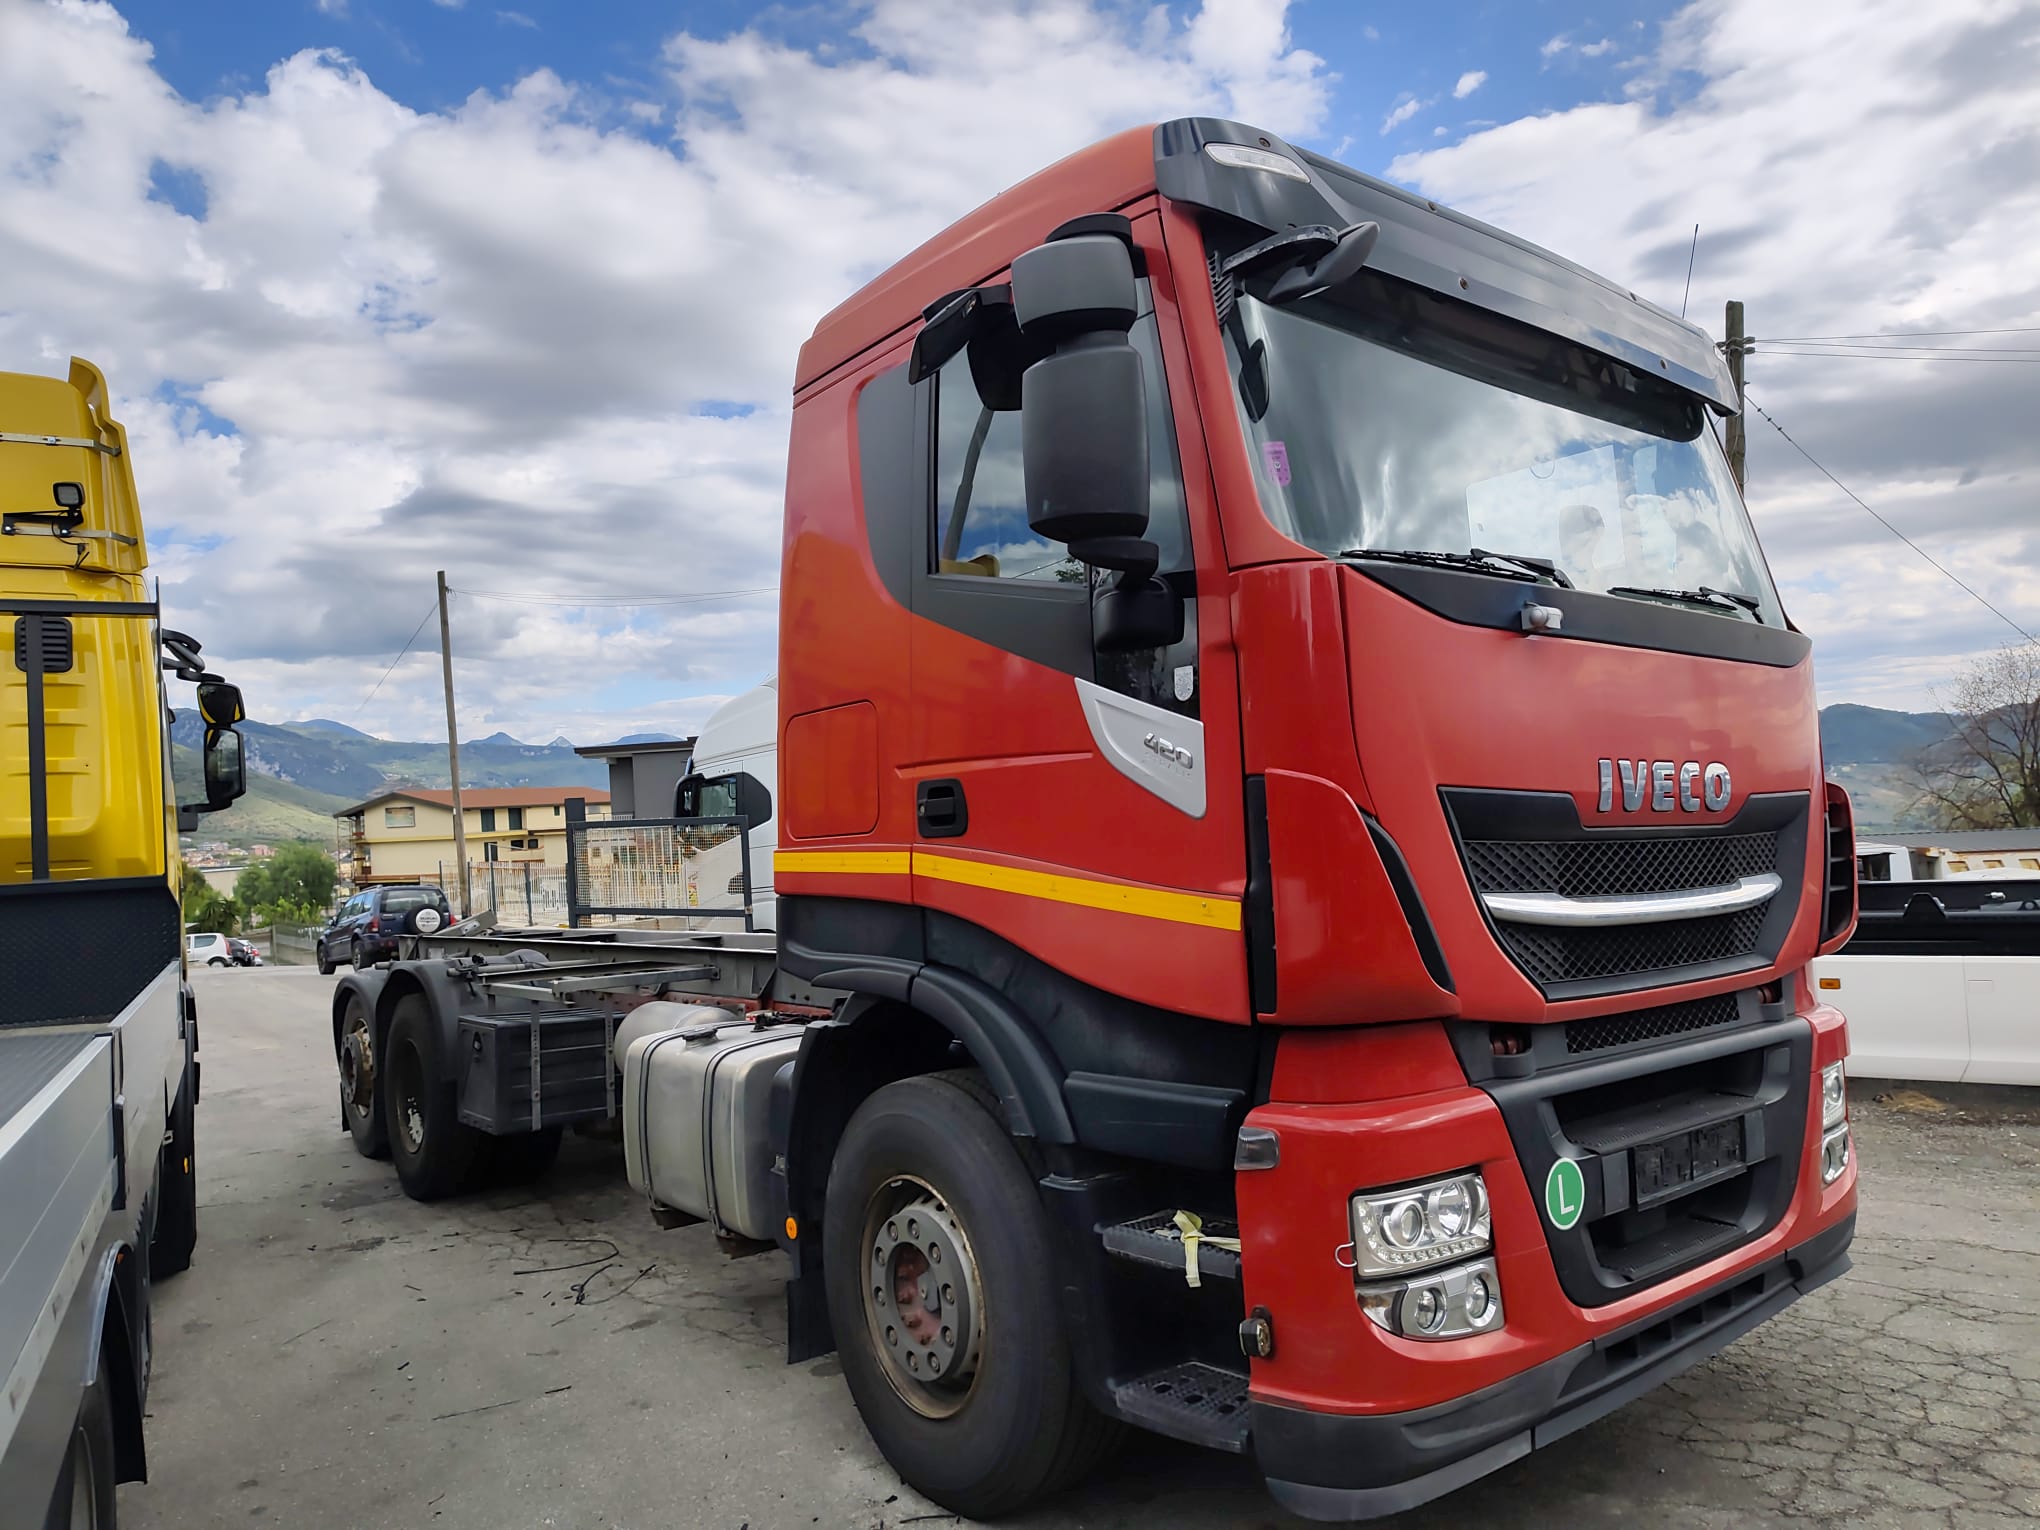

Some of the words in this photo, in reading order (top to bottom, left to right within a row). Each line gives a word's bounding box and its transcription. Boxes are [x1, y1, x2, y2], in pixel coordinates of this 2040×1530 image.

[1144, 732, 1193, 769] 420
[1598, 758, 1732, 812] IVECO
[1557, 1174, 1575, 1215] L
